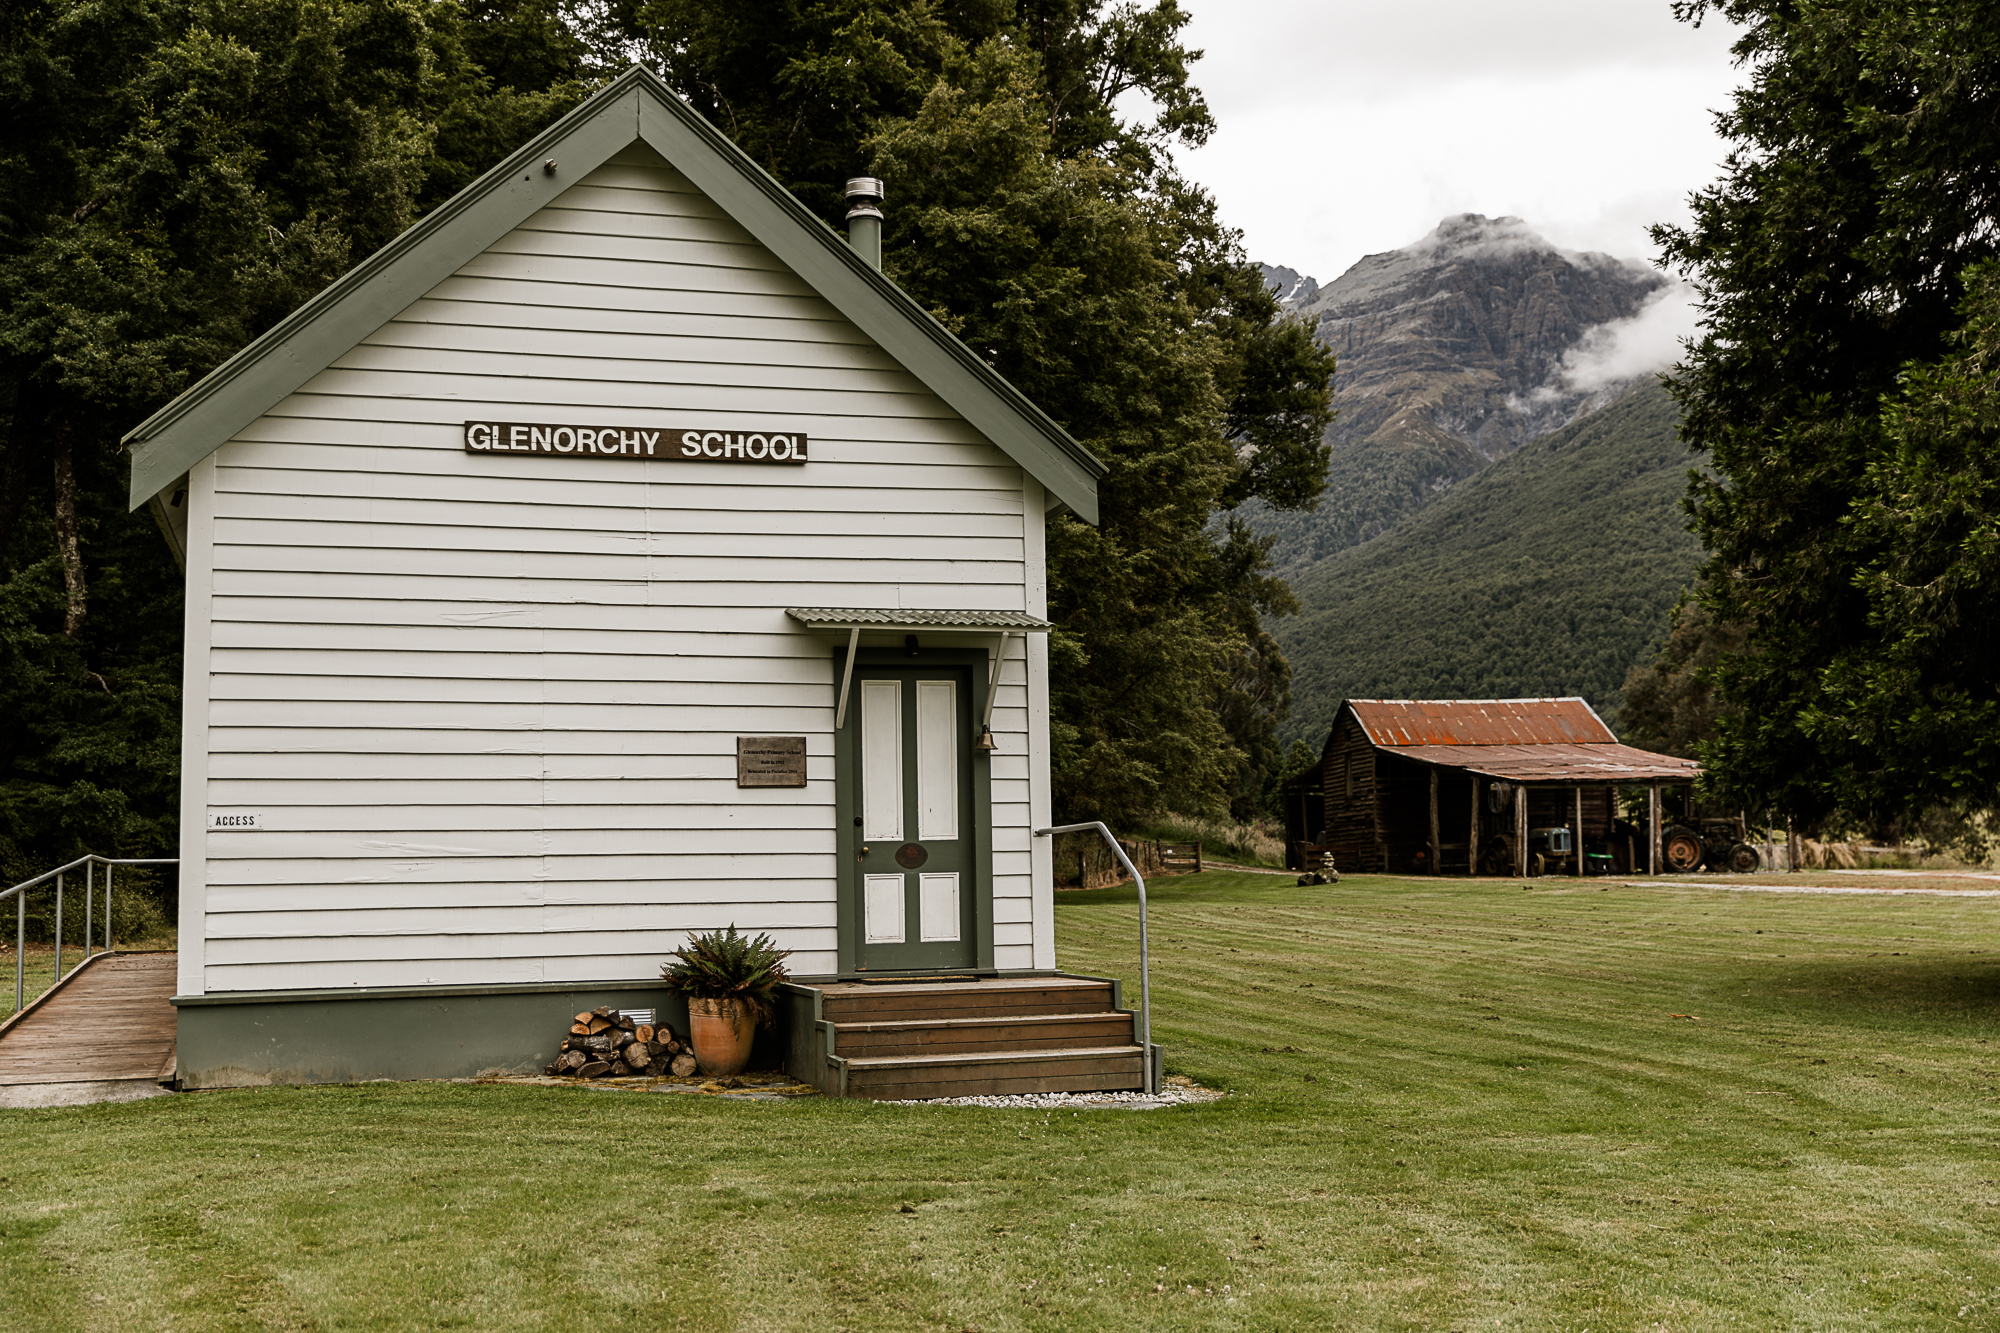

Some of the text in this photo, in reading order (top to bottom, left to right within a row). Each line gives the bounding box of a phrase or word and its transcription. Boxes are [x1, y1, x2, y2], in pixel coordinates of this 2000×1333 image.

[467, 423, 807, 460] GLENORCHY SCHOOL
[215, 816, 255, 826] ACCESS
